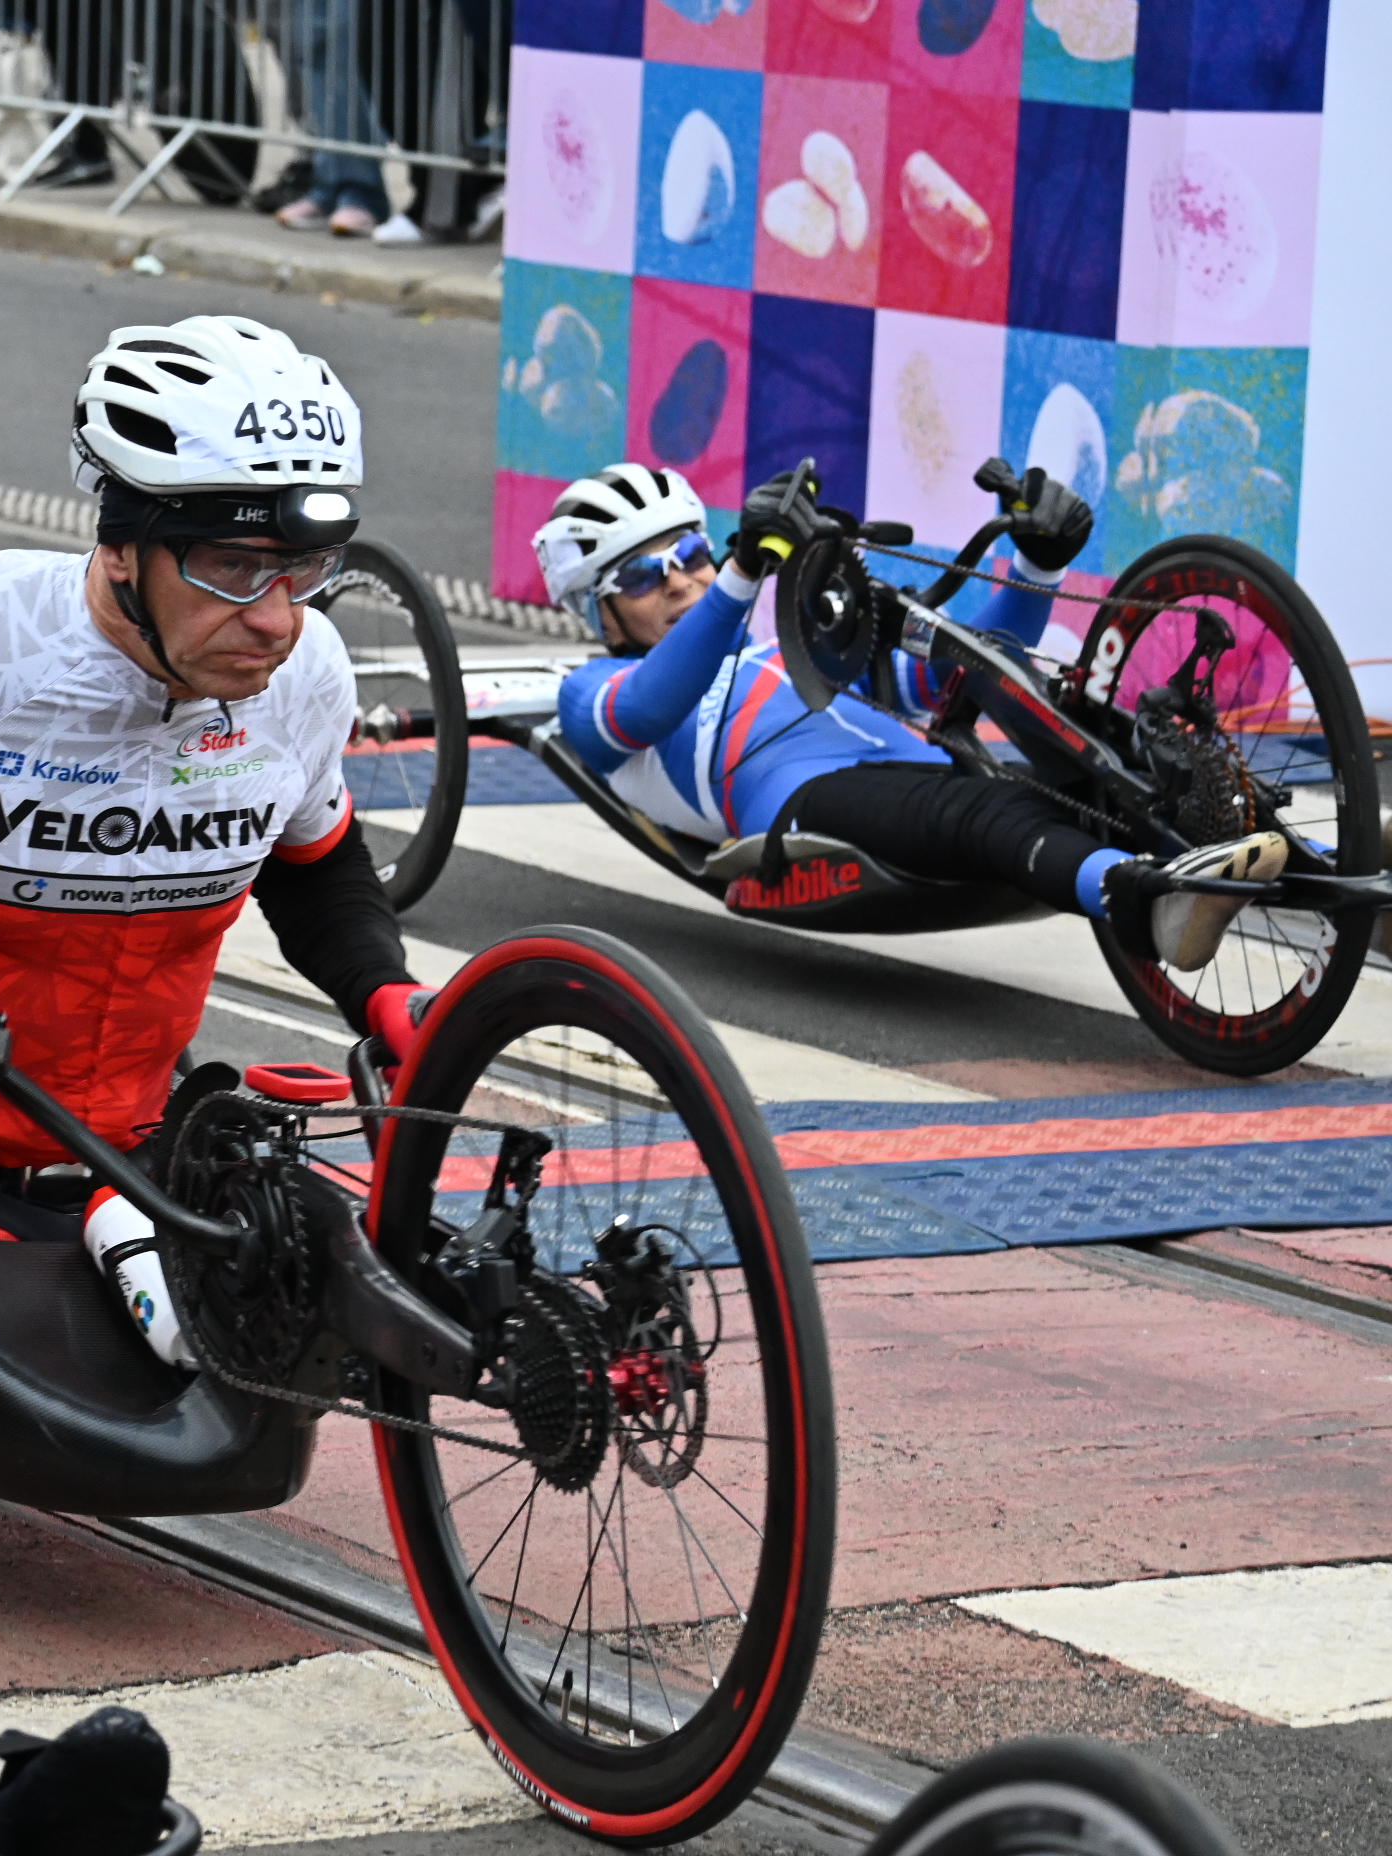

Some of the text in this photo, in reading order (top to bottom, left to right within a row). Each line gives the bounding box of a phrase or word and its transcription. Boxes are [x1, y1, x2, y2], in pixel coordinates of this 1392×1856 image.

[234, 398, 345, 446] 4350
[198, 728, 247, 753] Start
[32, 759, 120, 785] Kraków
[194, 758, 264, 781] HABYS
[61, 888, 124, 903] nowa
